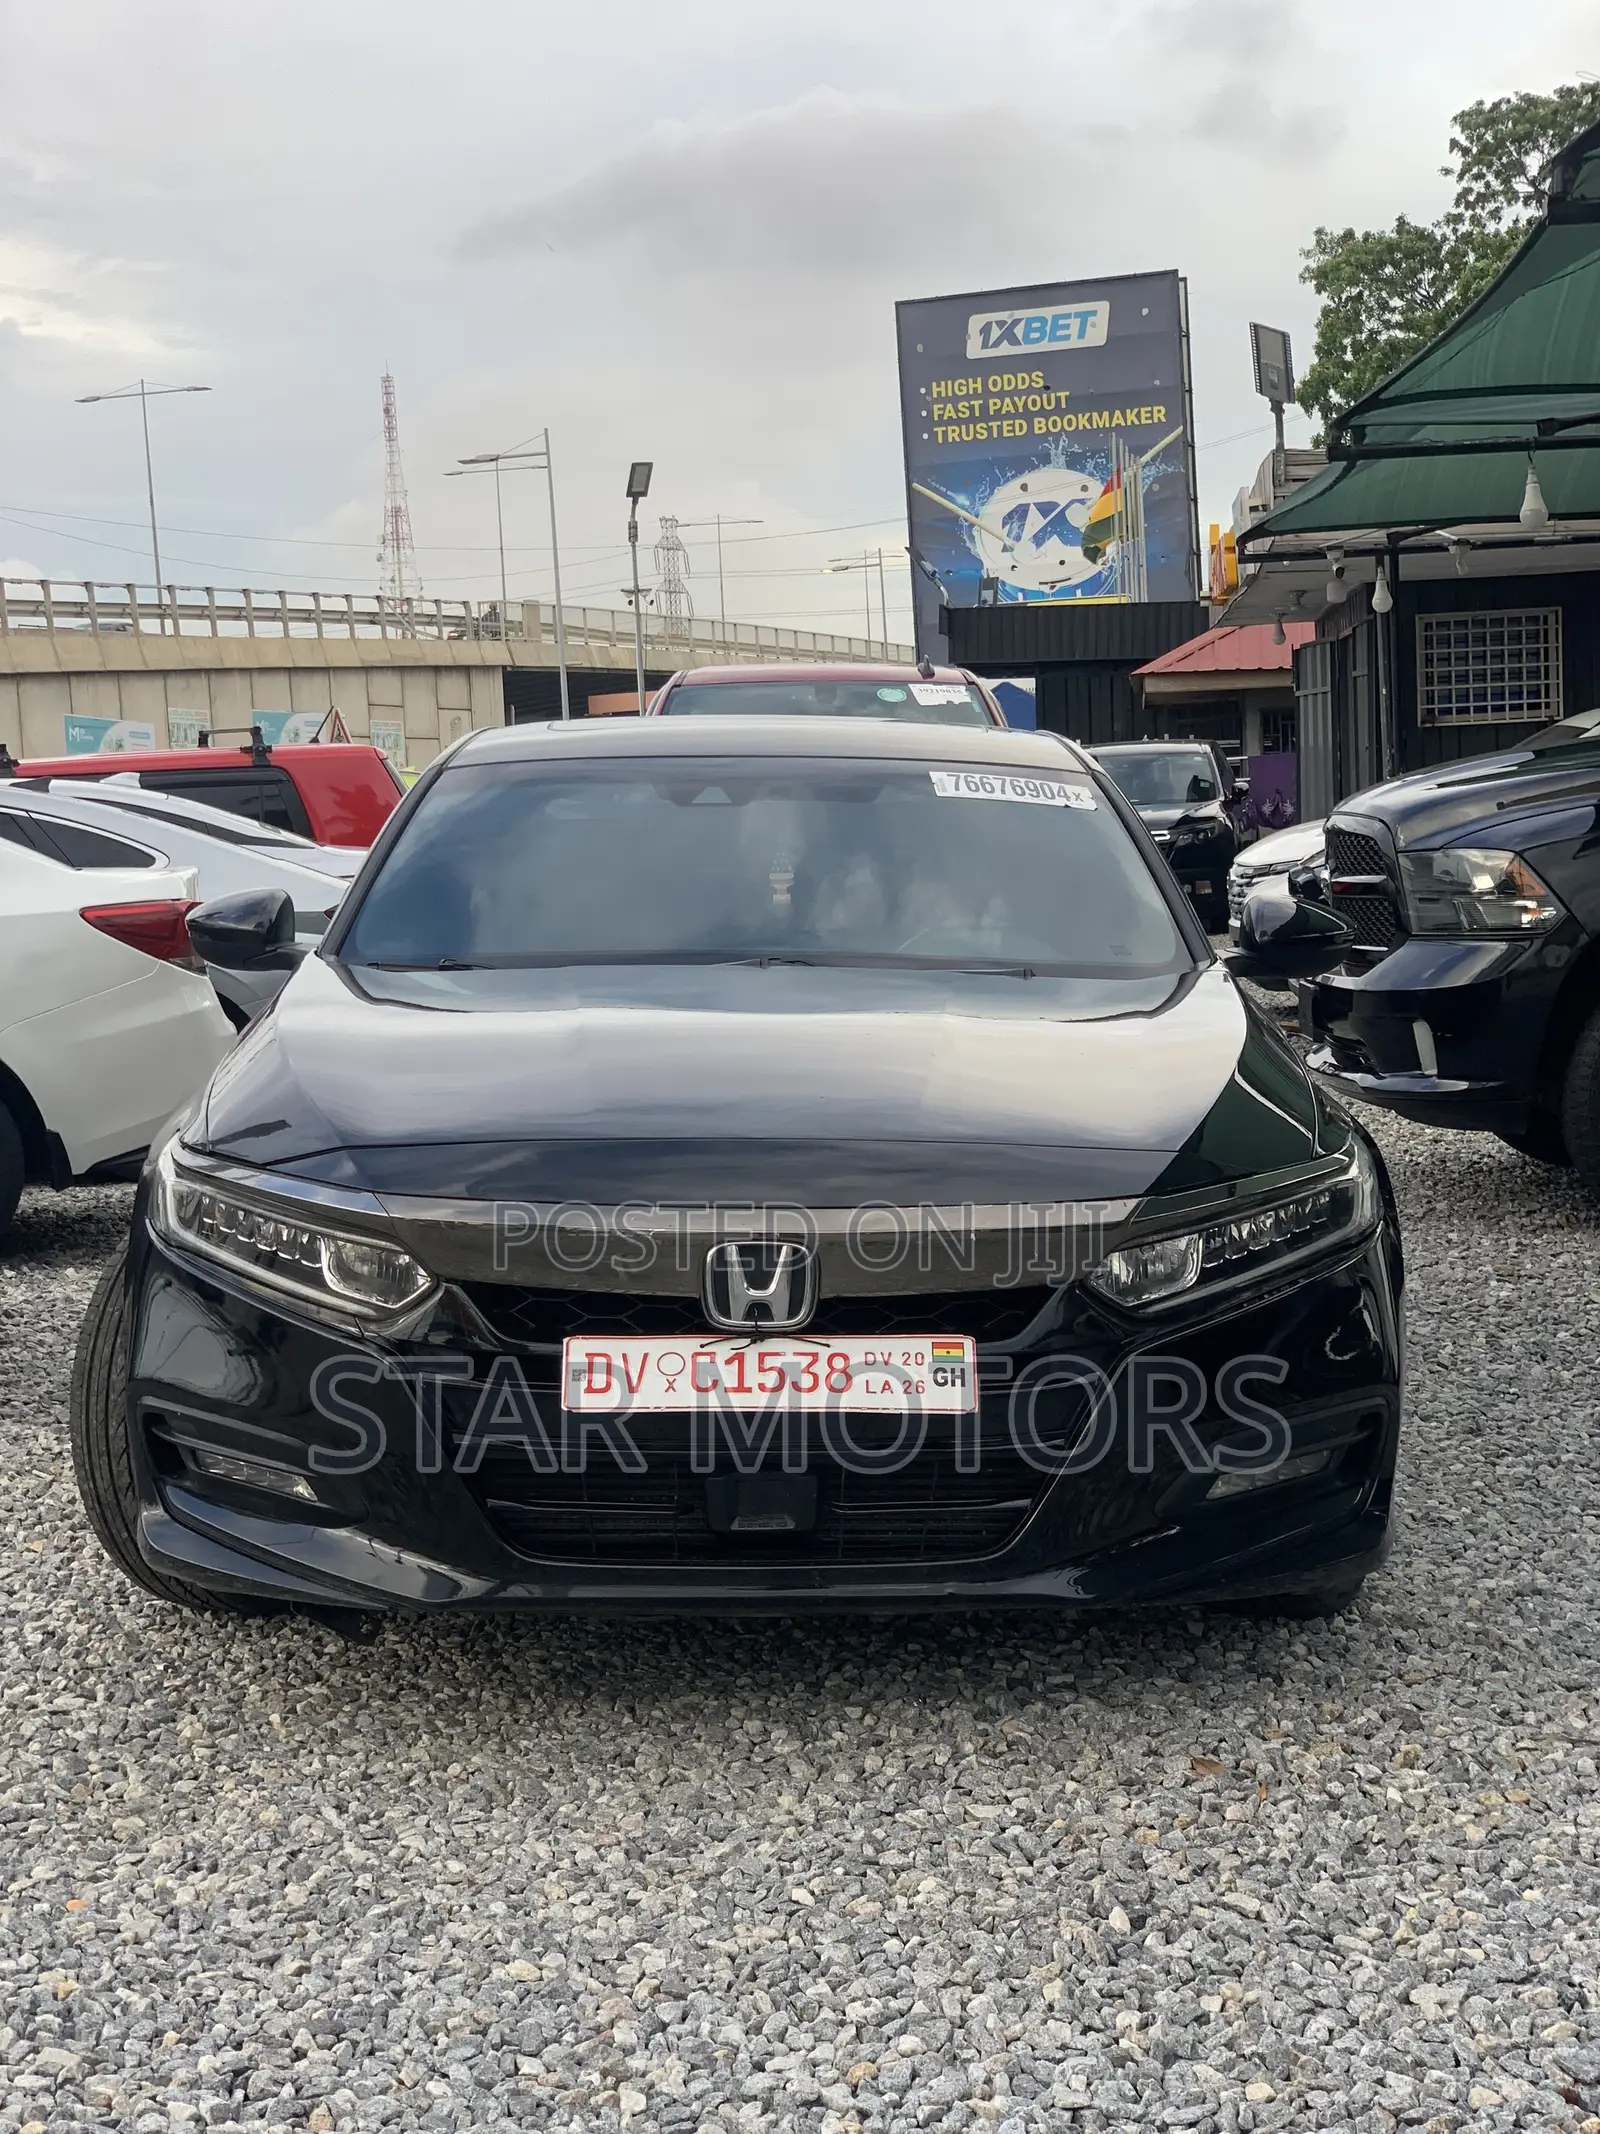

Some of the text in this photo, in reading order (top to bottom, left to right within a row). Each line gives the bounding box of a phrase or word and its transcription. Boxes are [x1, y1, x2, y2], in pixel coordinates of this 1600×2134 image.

[979, 310, 1098, 350] 1XBET
[932, 371, 1044, 398] HIGH ODDS
[933, 391, 1070, 421] FAST PAYOUT
[934, 405, 1167, 443] TRUSTED BOOKMAKER
[584, 1351, 649, 1394] DV
[690, 1351, 854, 1395] C1538
[865, 1351, 926, 1367] DV 20
[865, 1379, 926, 1395] LA 26
[932, 1366, 967, 1388] GH
